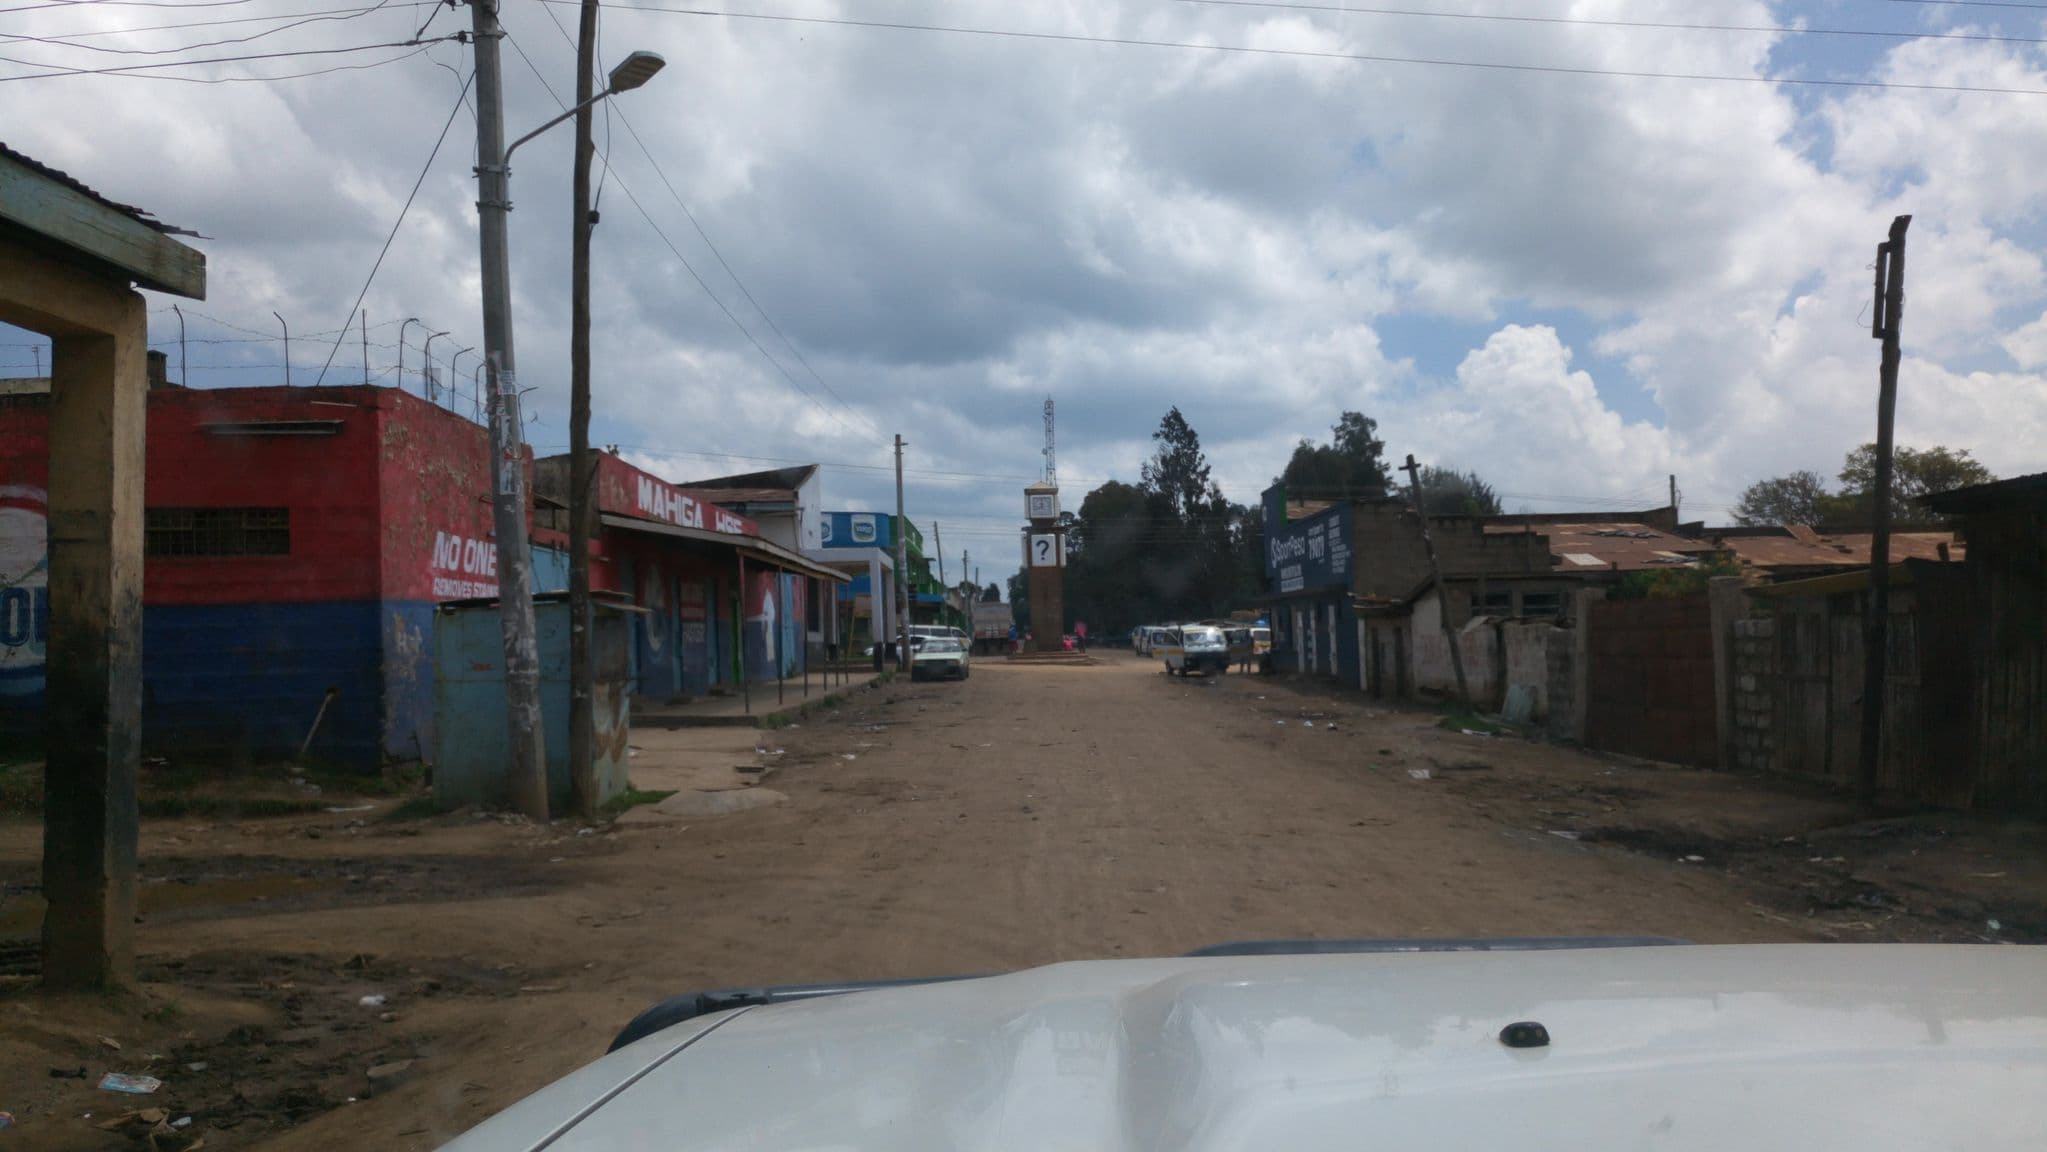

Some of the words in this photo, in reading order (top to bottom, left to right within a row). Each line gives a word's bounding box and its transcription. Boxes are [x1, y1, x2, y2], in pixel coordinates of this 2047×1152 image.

[638, 474, 703, 529] MAHIGA
[432, 530, 462, 571] NO
[463, 538, 497, 577] ONE
